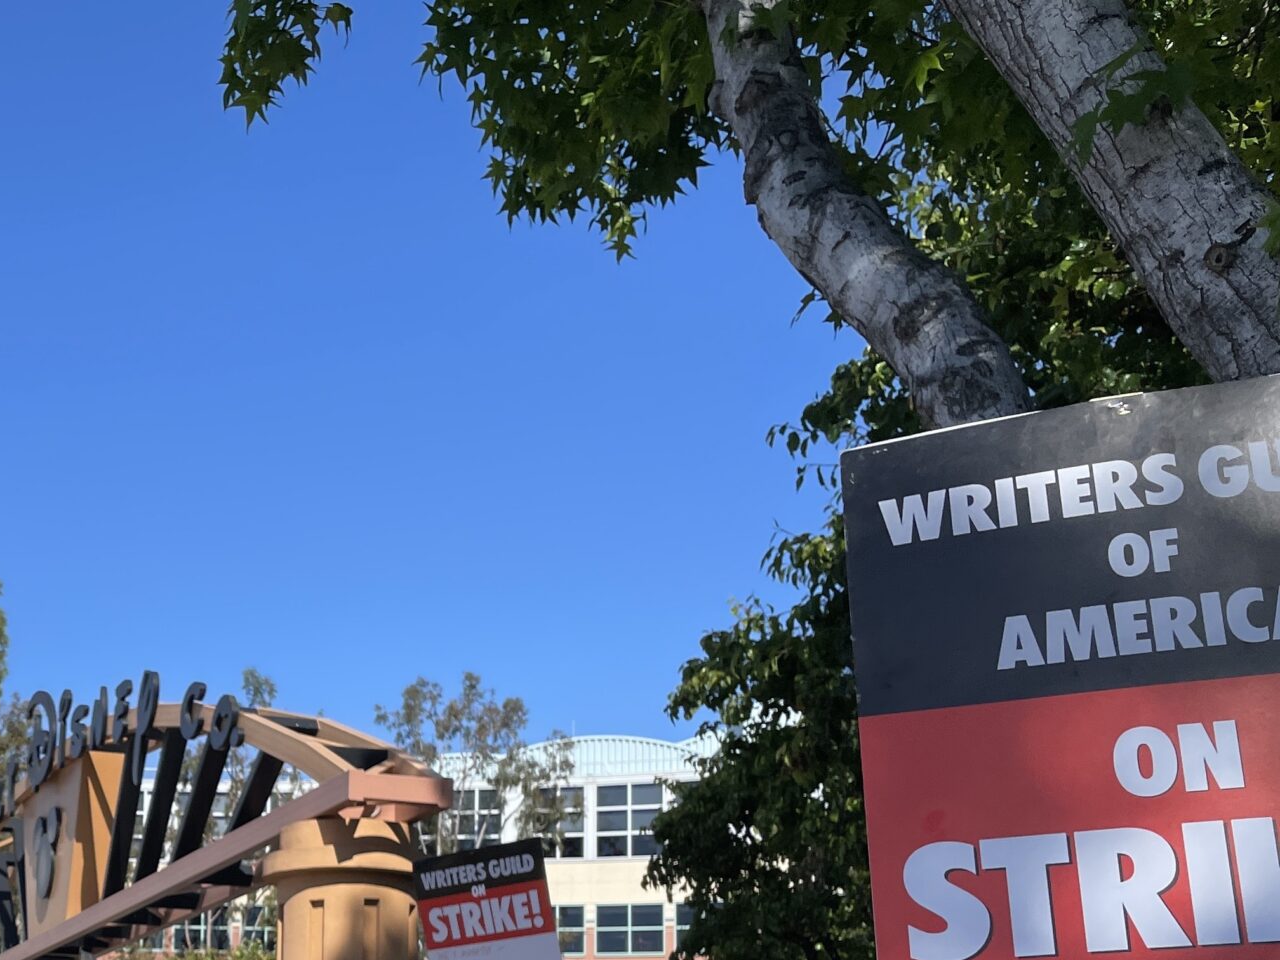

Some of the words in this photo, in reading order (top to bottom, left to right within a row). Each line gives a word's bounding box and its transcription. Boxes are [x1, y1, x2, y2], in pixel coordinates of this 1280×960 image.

[878, 452, 1184, 546] WRITERS
[1107, 528, 1178, 577] OF
[996, 586, 1280, 670] AMERIC
[1113, 719, 1245, 797] ON
[420, 862, 486, 891] WRITERS
[488, 853, 535, 879] GUILD
[471, 884, 486, 898] ON
[428, 889, 544, 943] STRIKE!
